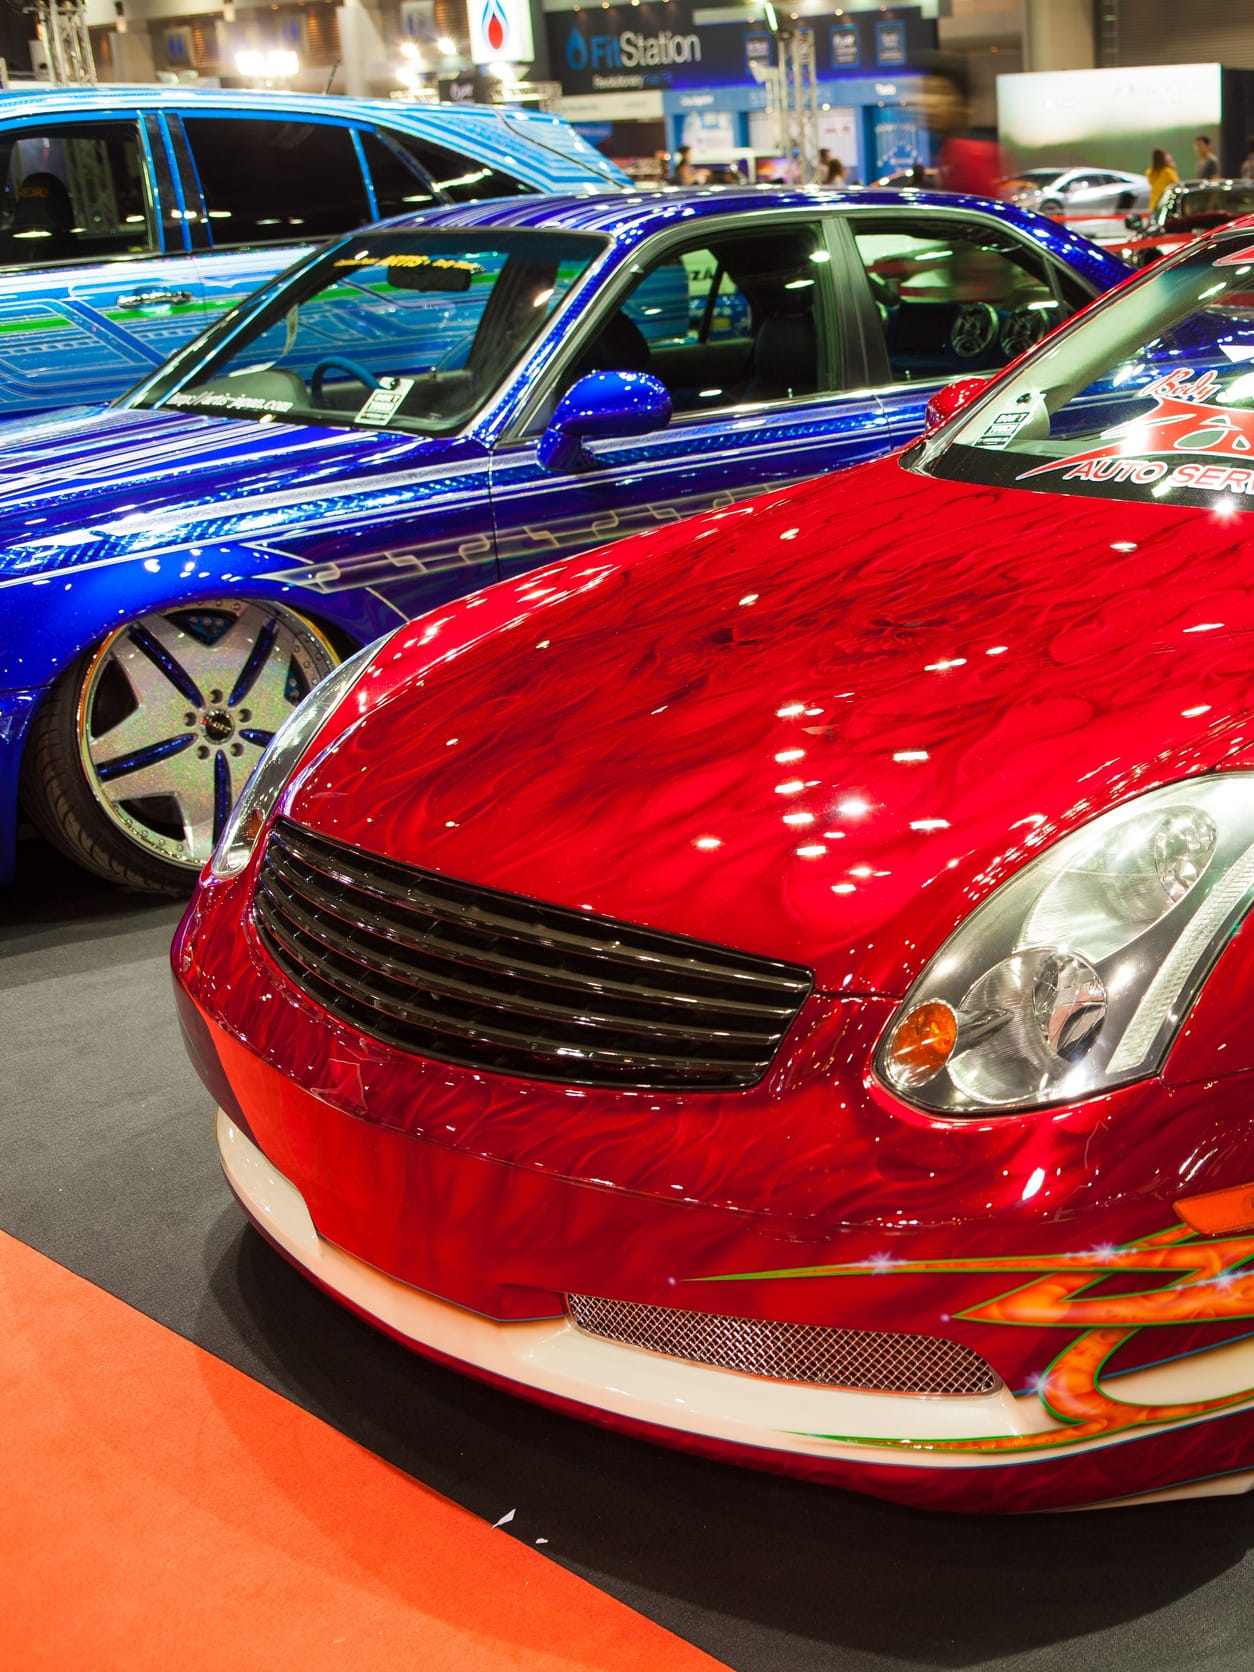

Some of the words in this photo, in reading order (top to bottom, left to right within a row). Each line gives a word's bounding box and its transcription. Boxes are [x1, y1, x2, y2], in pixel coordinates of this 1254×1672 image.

[590, 30, 702, 69] FitStation
[1139, 369, 1222, 400] Body
[1066, 460, 1170, 484] AUTO
